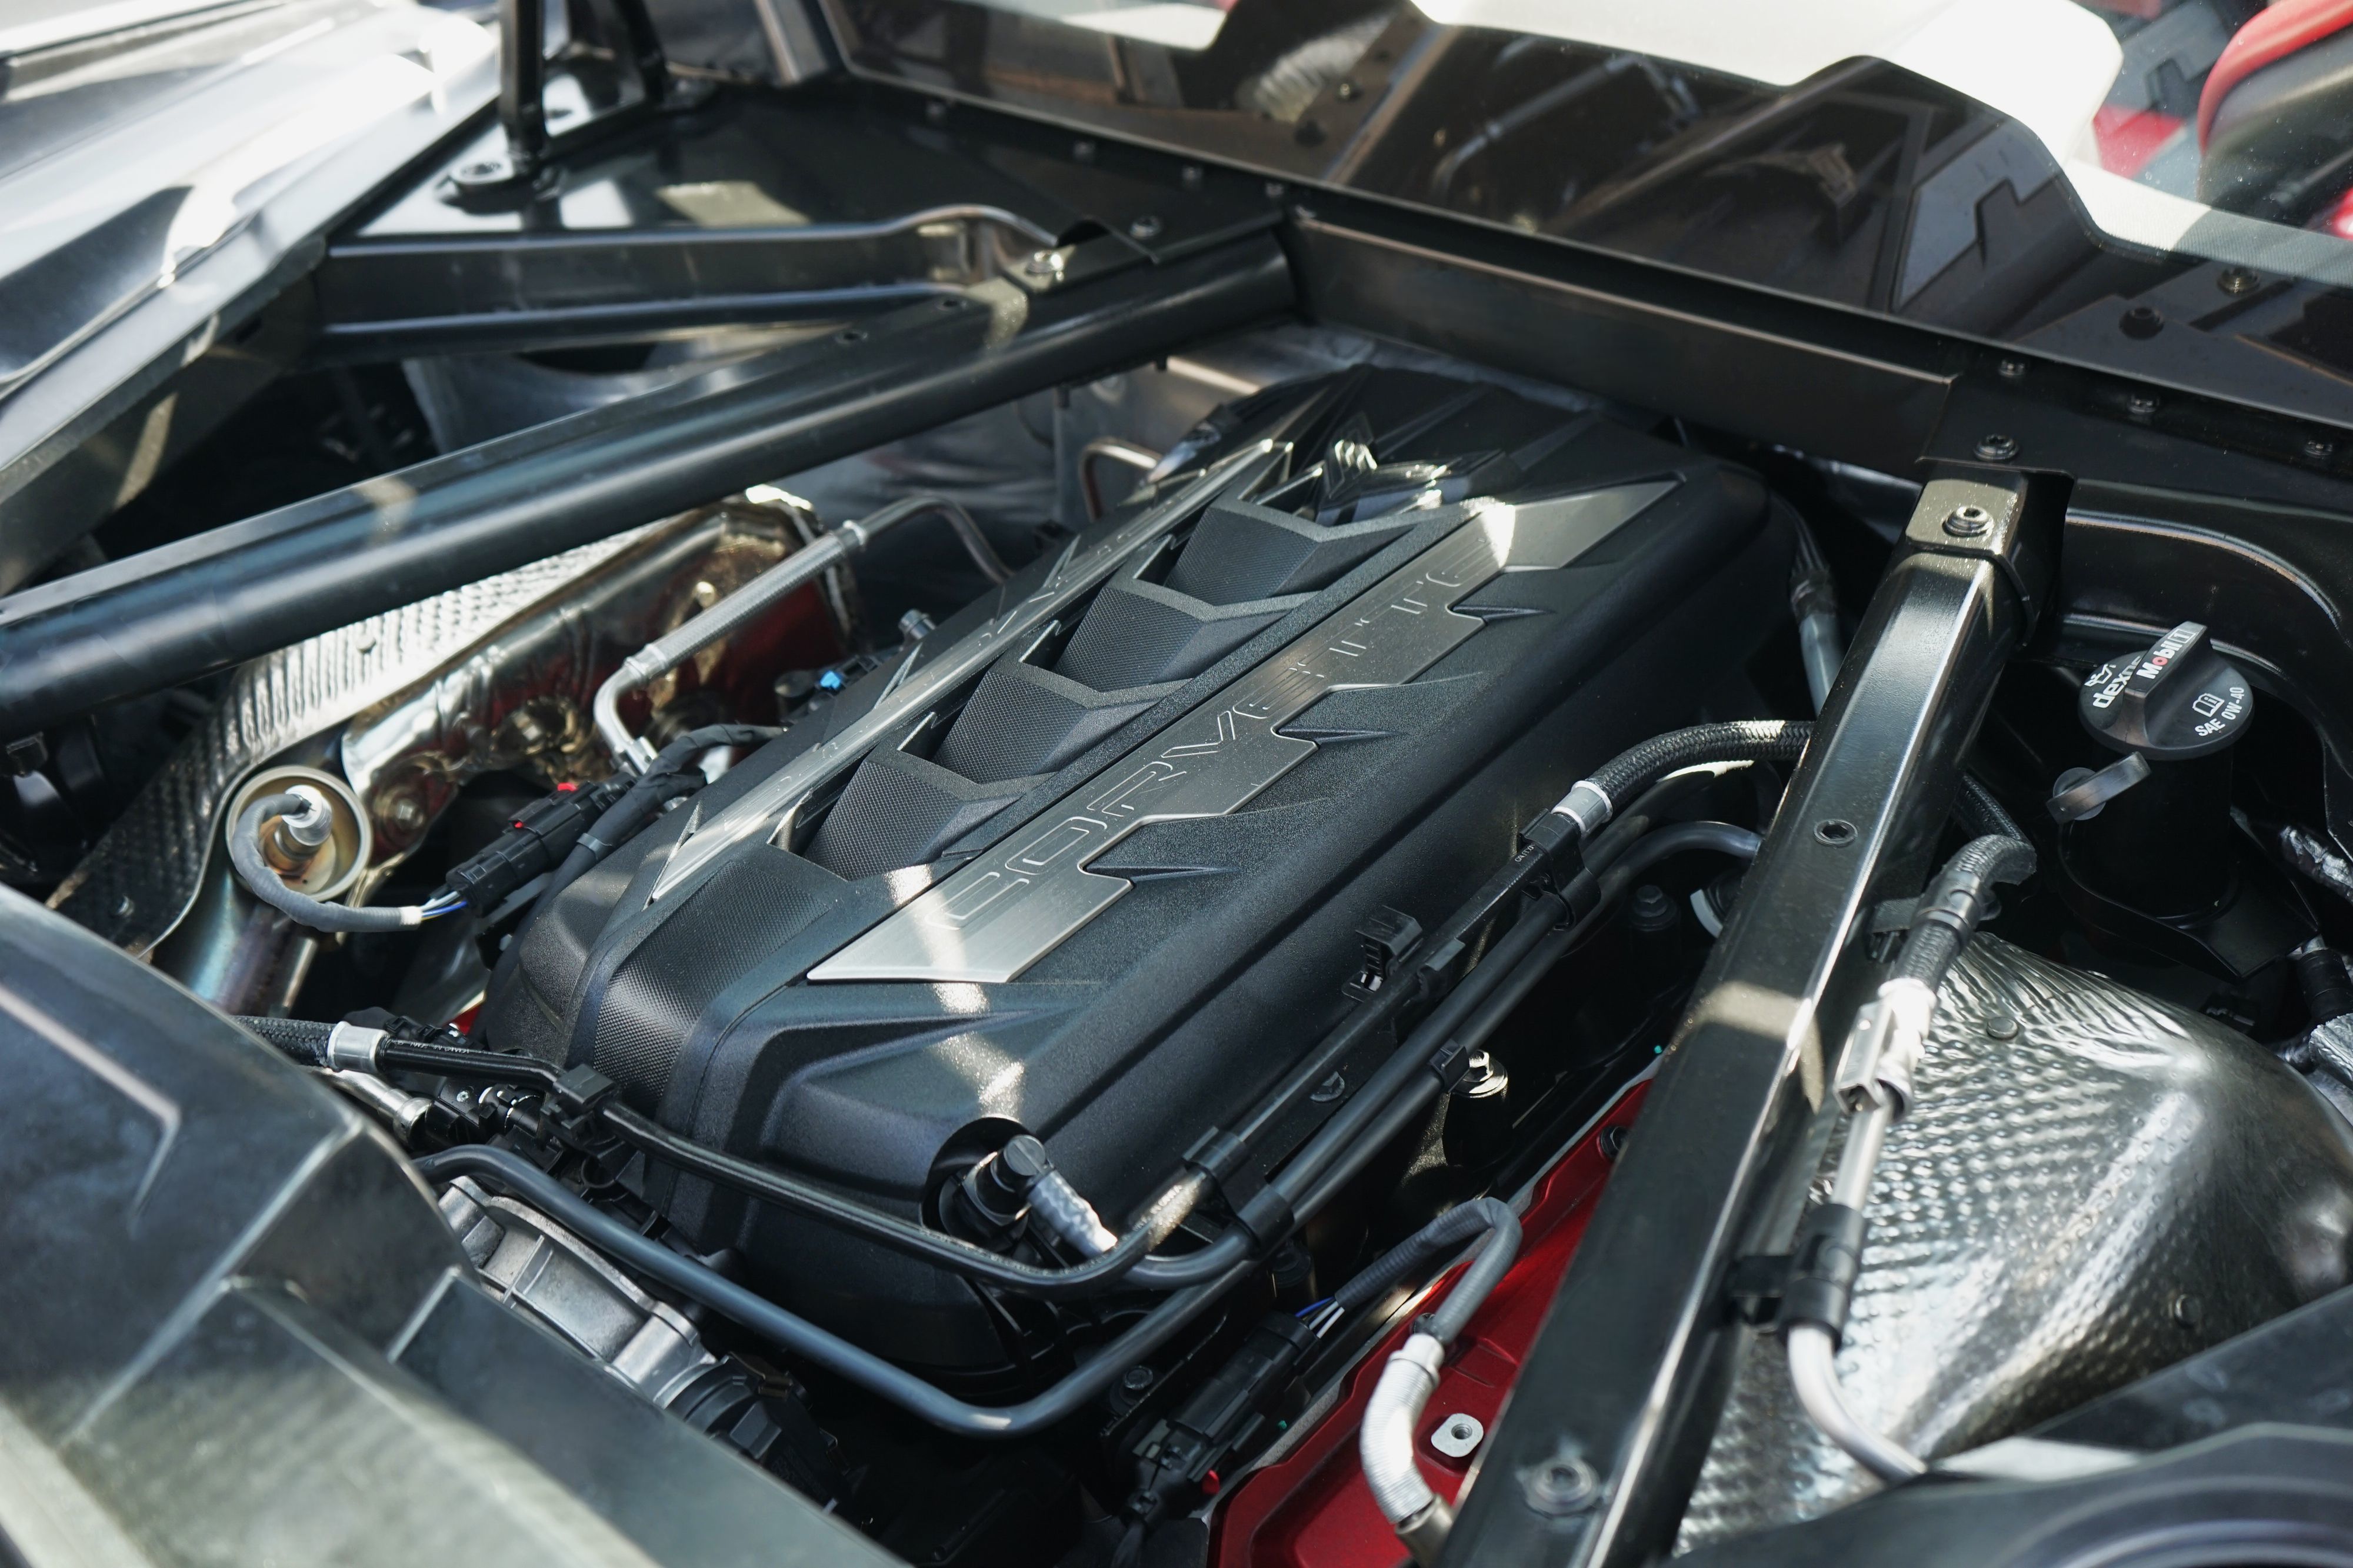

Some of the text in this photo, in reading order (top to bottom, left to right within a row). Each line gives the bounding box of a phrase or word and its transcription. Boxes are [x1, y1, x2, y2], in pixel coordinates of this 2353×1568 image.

[2136, 640, 2183, 679] Mobil
[924, 536, 1497, 931] CORVETTE
[2194, 687, 2244, 736] SAE 0W-40
